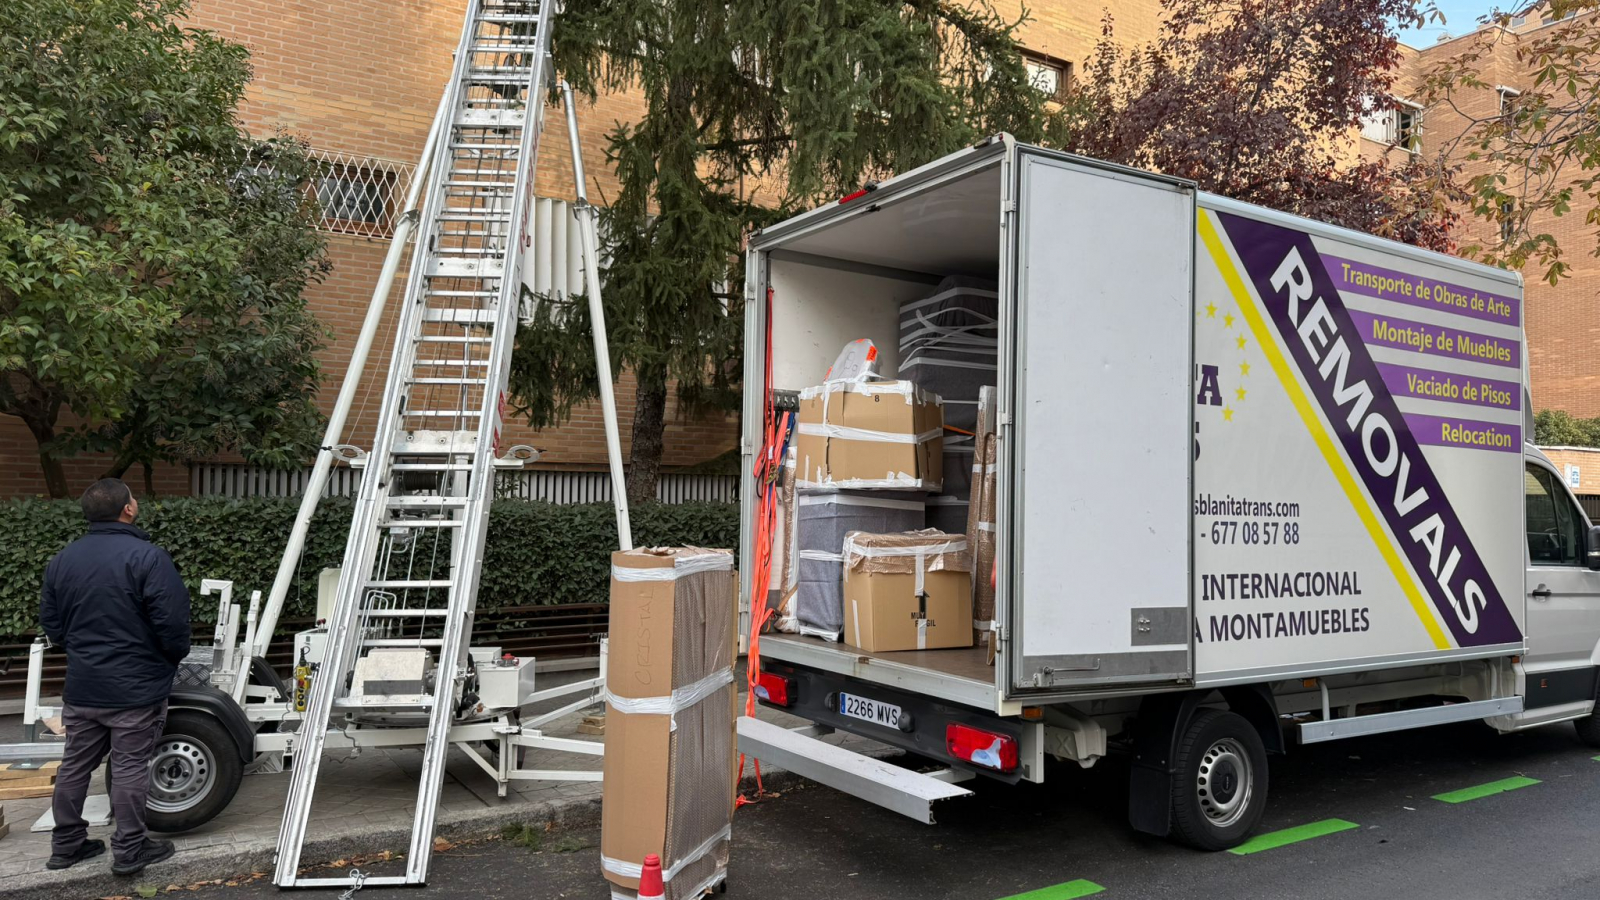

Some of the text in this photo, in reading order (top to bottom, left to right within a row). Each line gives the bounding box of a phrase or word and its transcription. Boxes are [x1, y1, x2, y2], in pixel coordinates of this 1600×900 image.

[1341, 263, 1511, 317] Transporte de Obras de Arte
[1373, 319, 1511, 362] Montaje de Muebles
[1196, 364, 1222, 406] A
[1406, 373, 1511, 406] Vaciado de Pisos
[1270, 245, 1487, 634] REMOVALS
[1441, 422, 1512, 447] Relocation
[1211, 520, 1238, 545] 677
[1242, 521, 1259, 545] 08
[1263, 522, 1279, 545] 57
[1283, 522, 1300, 545] 88
[1202, 571, 1362, 601] INTERNACIONAL
[914, 619, 936, 627] FGIL
[1210, 607, 1370, 642] MONTAMUEBLES
[847, 697, 898, 726] 2266 MVS
